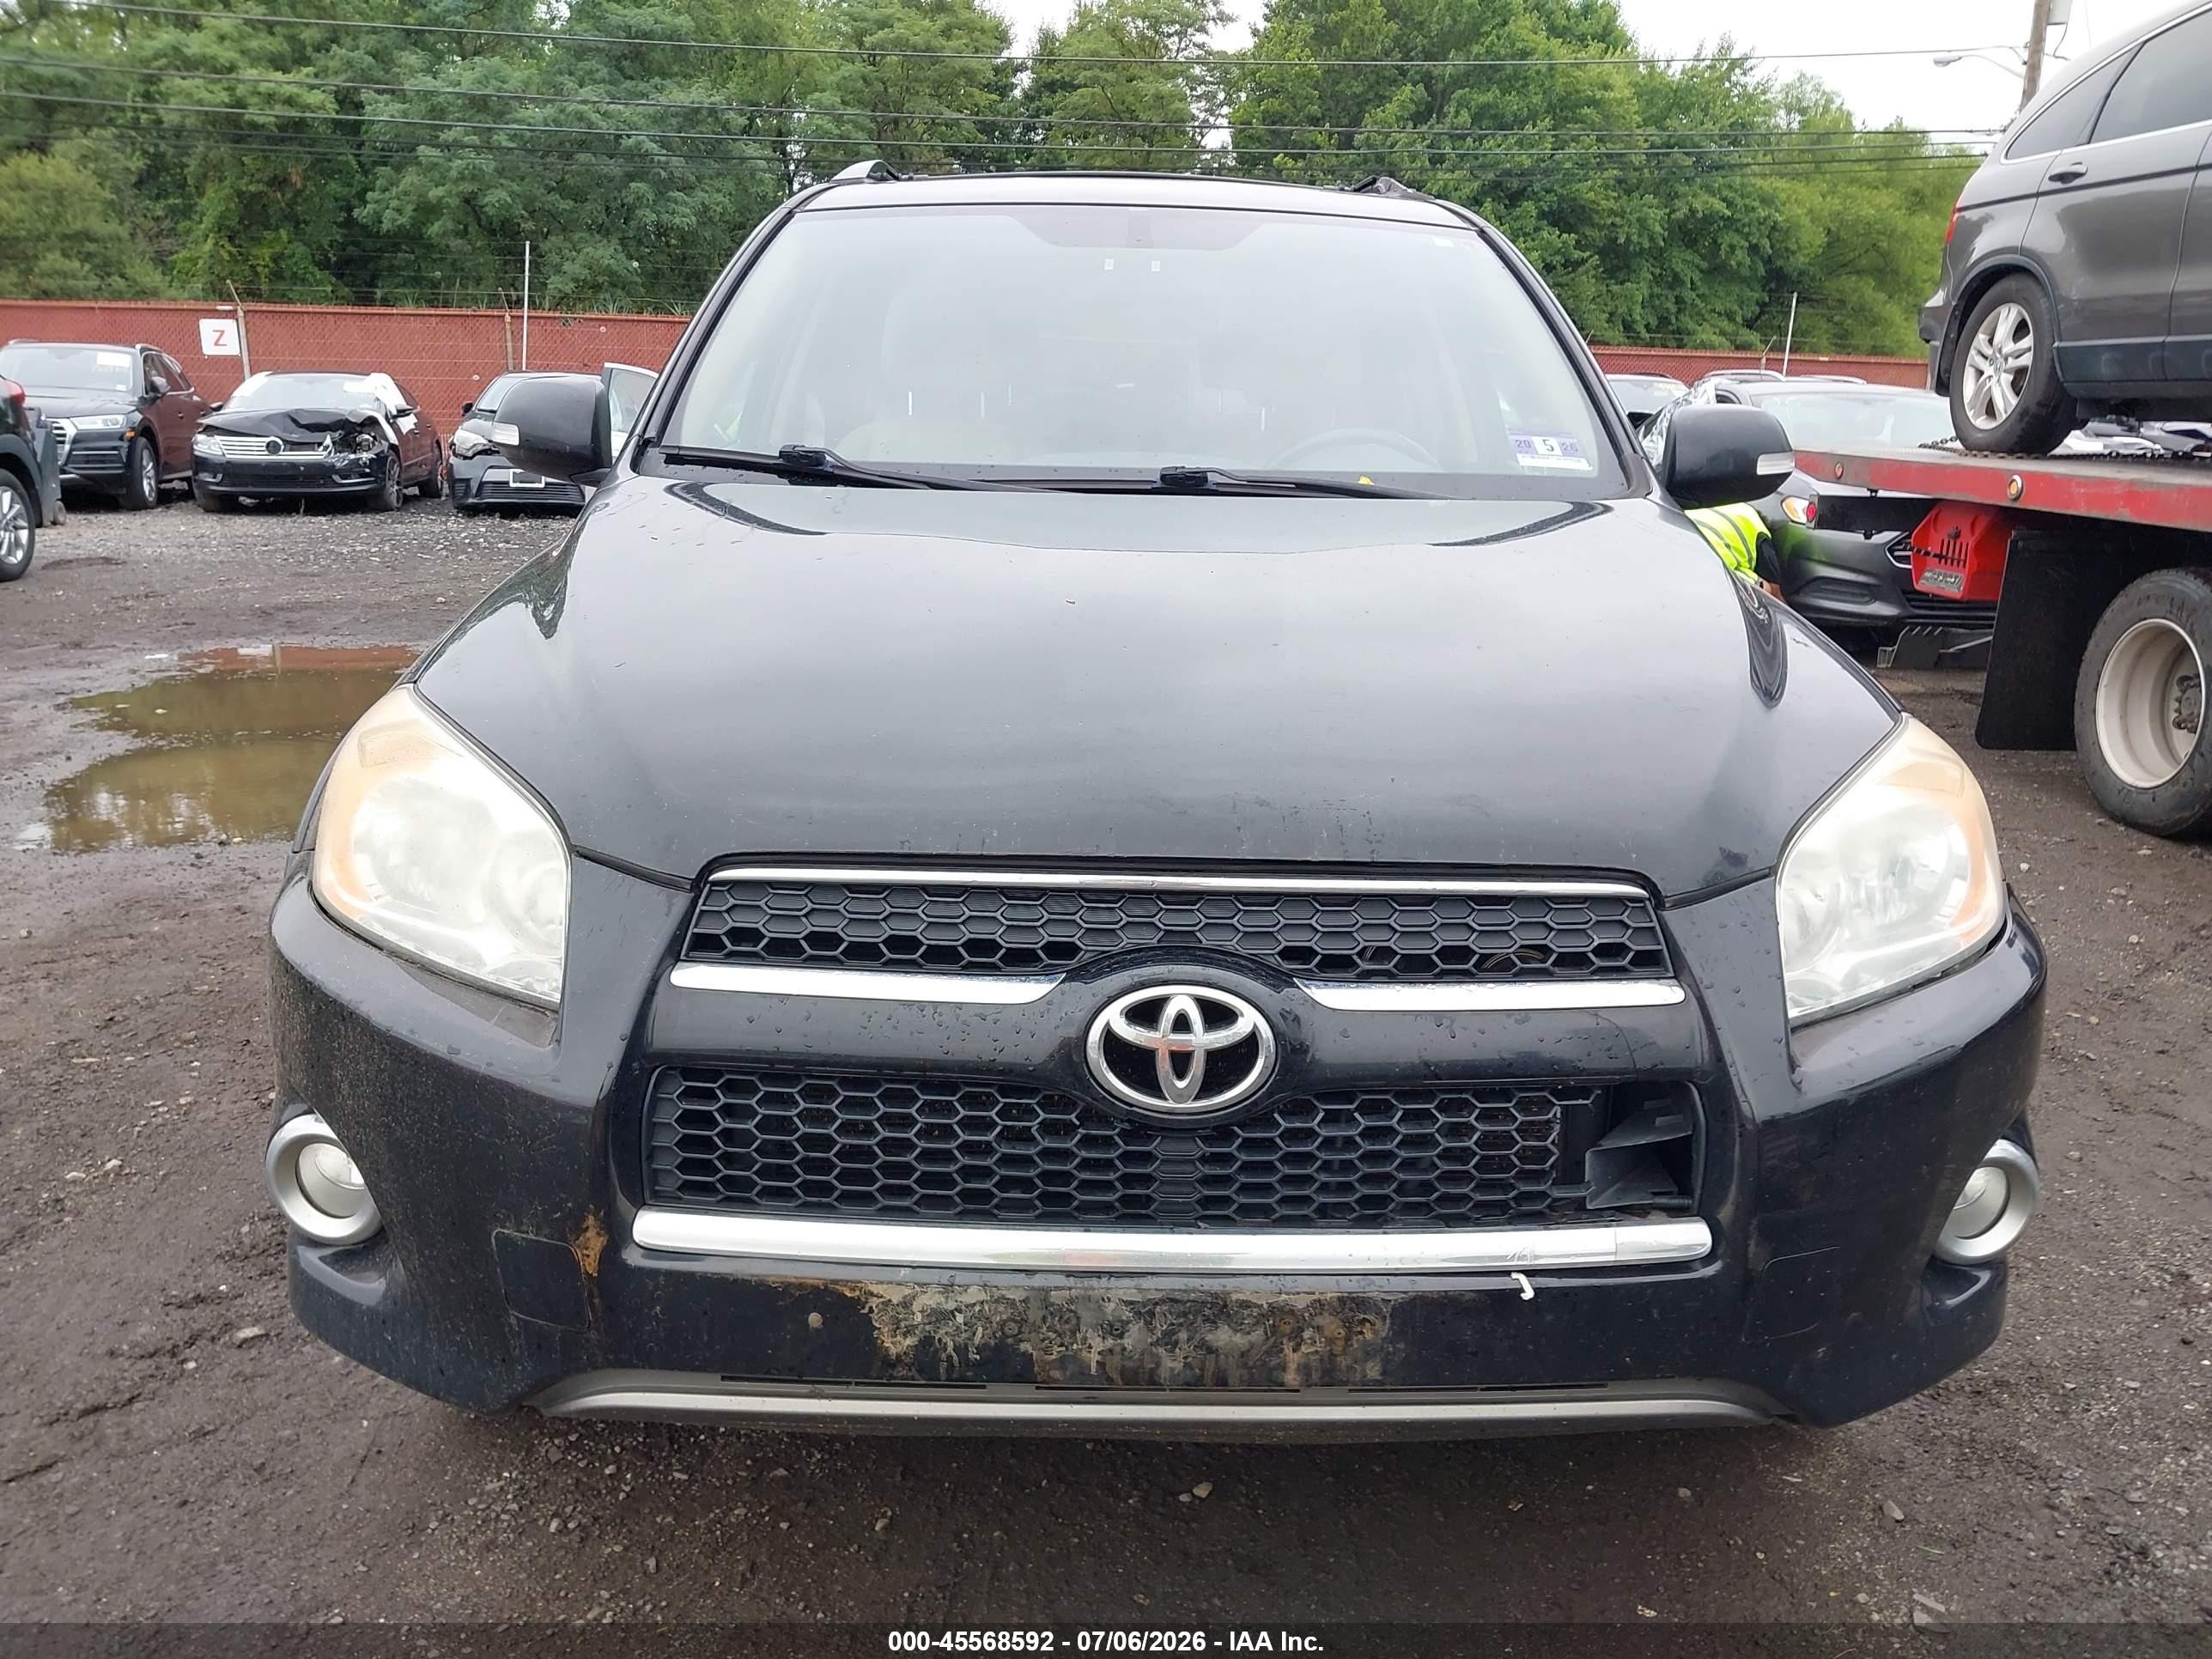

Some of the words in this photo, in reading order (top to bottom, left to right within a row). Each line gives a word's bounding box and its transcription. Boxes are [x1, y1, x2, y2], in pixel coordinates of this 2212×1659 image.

[212, 329, 228, 346] Z
[1515, 439, 1532, 449] 20
[1542, 439, 1555, 453] 5
